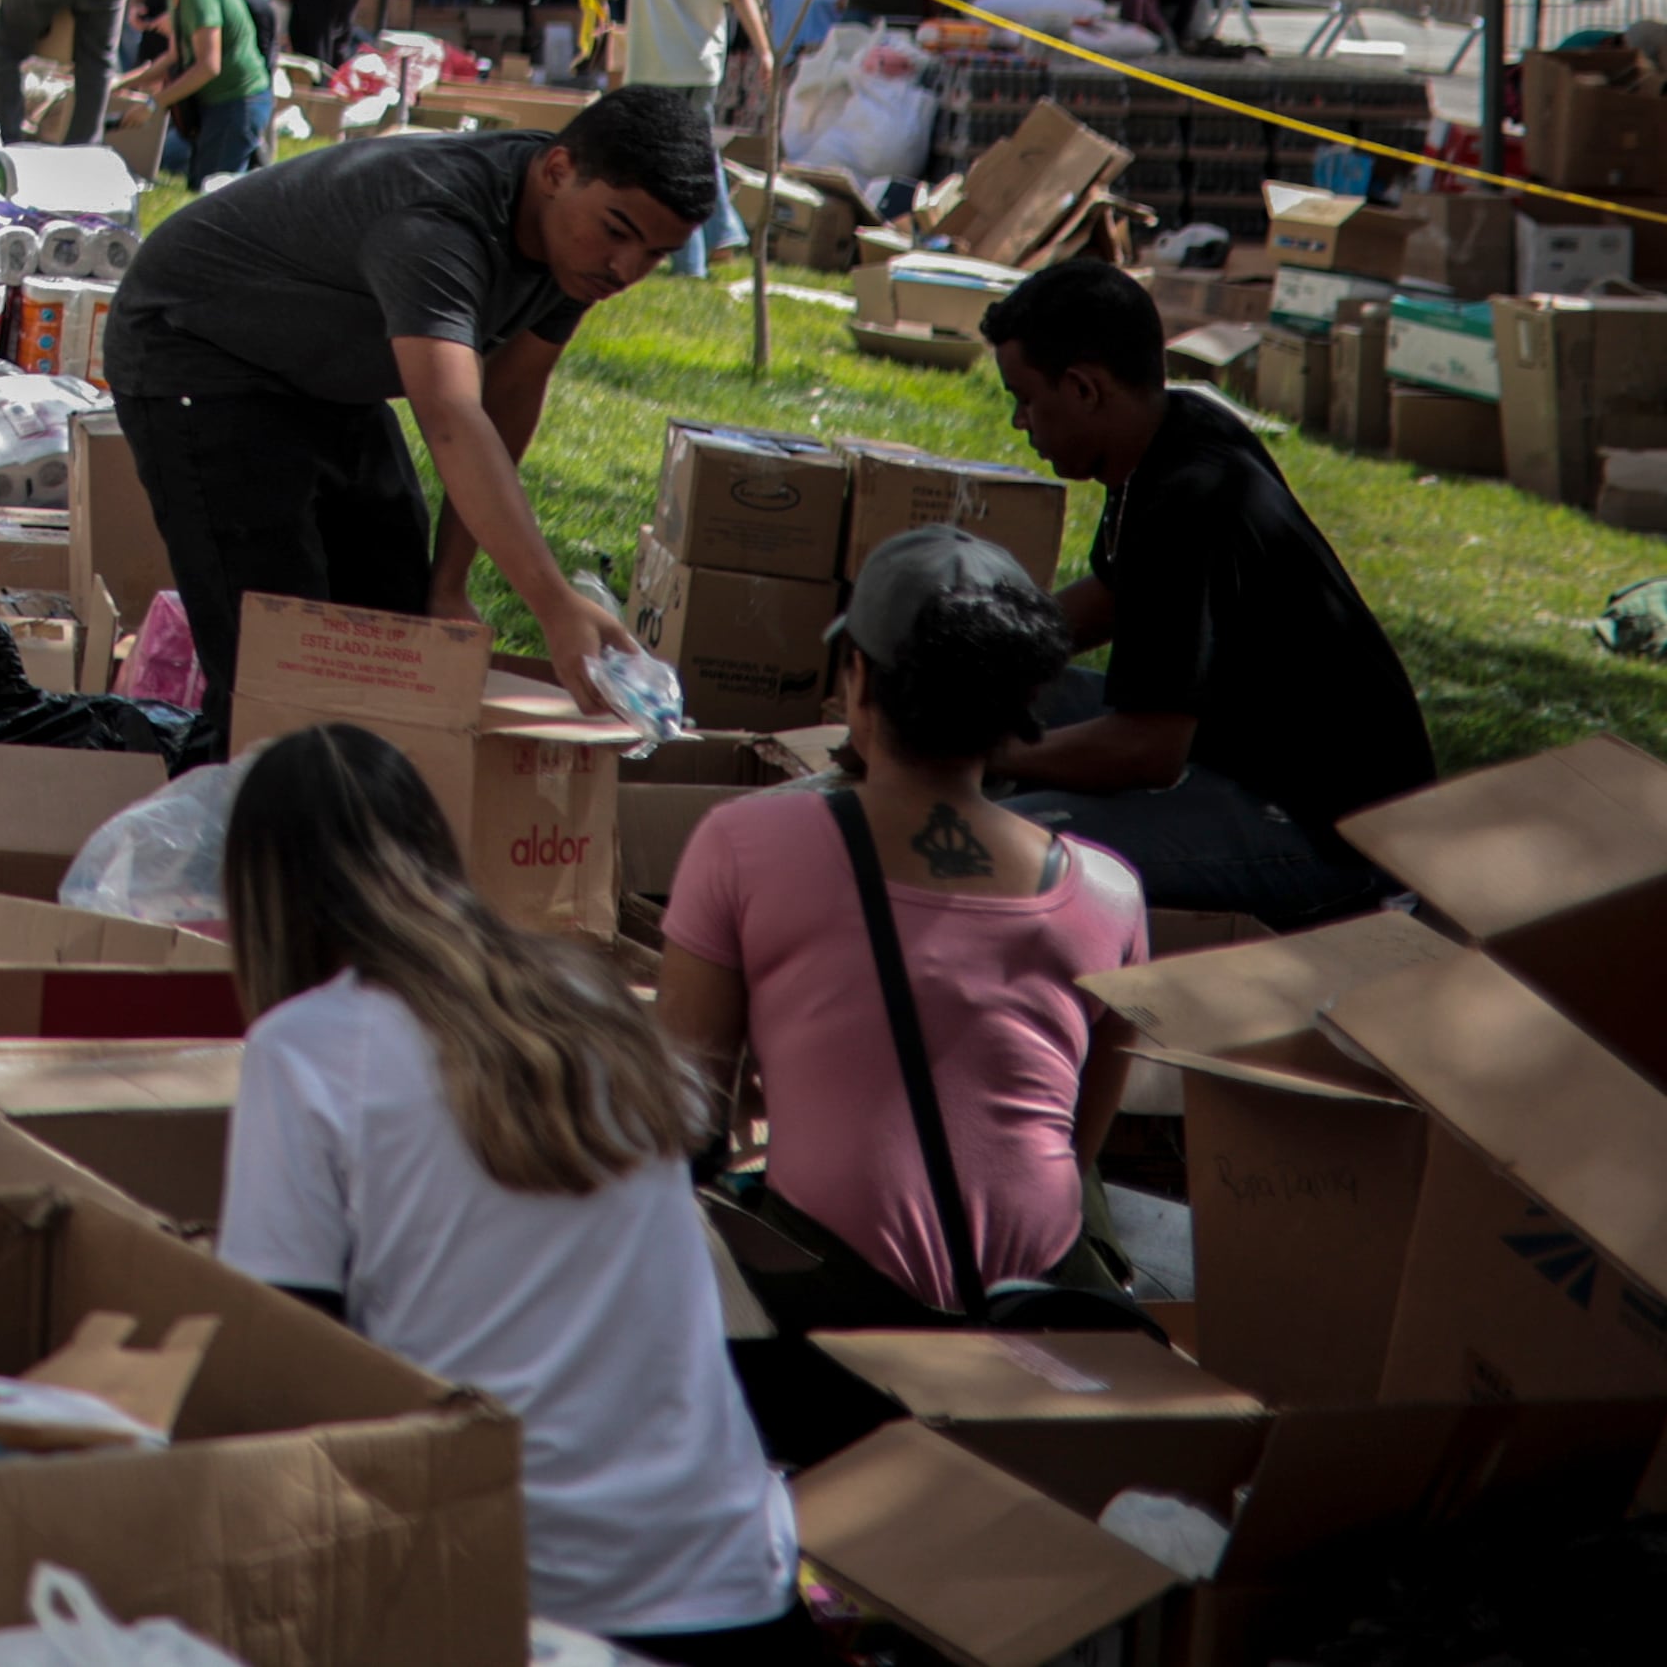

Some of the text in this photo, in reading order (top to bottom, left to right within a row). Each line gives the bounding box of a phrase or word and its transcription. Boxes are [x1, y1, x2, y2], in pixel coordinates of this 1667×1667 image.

[301, 633, 332, 650] ESTE
[335, 640, 370, 659] LADO
[510, 823, 593, 867] aldor
